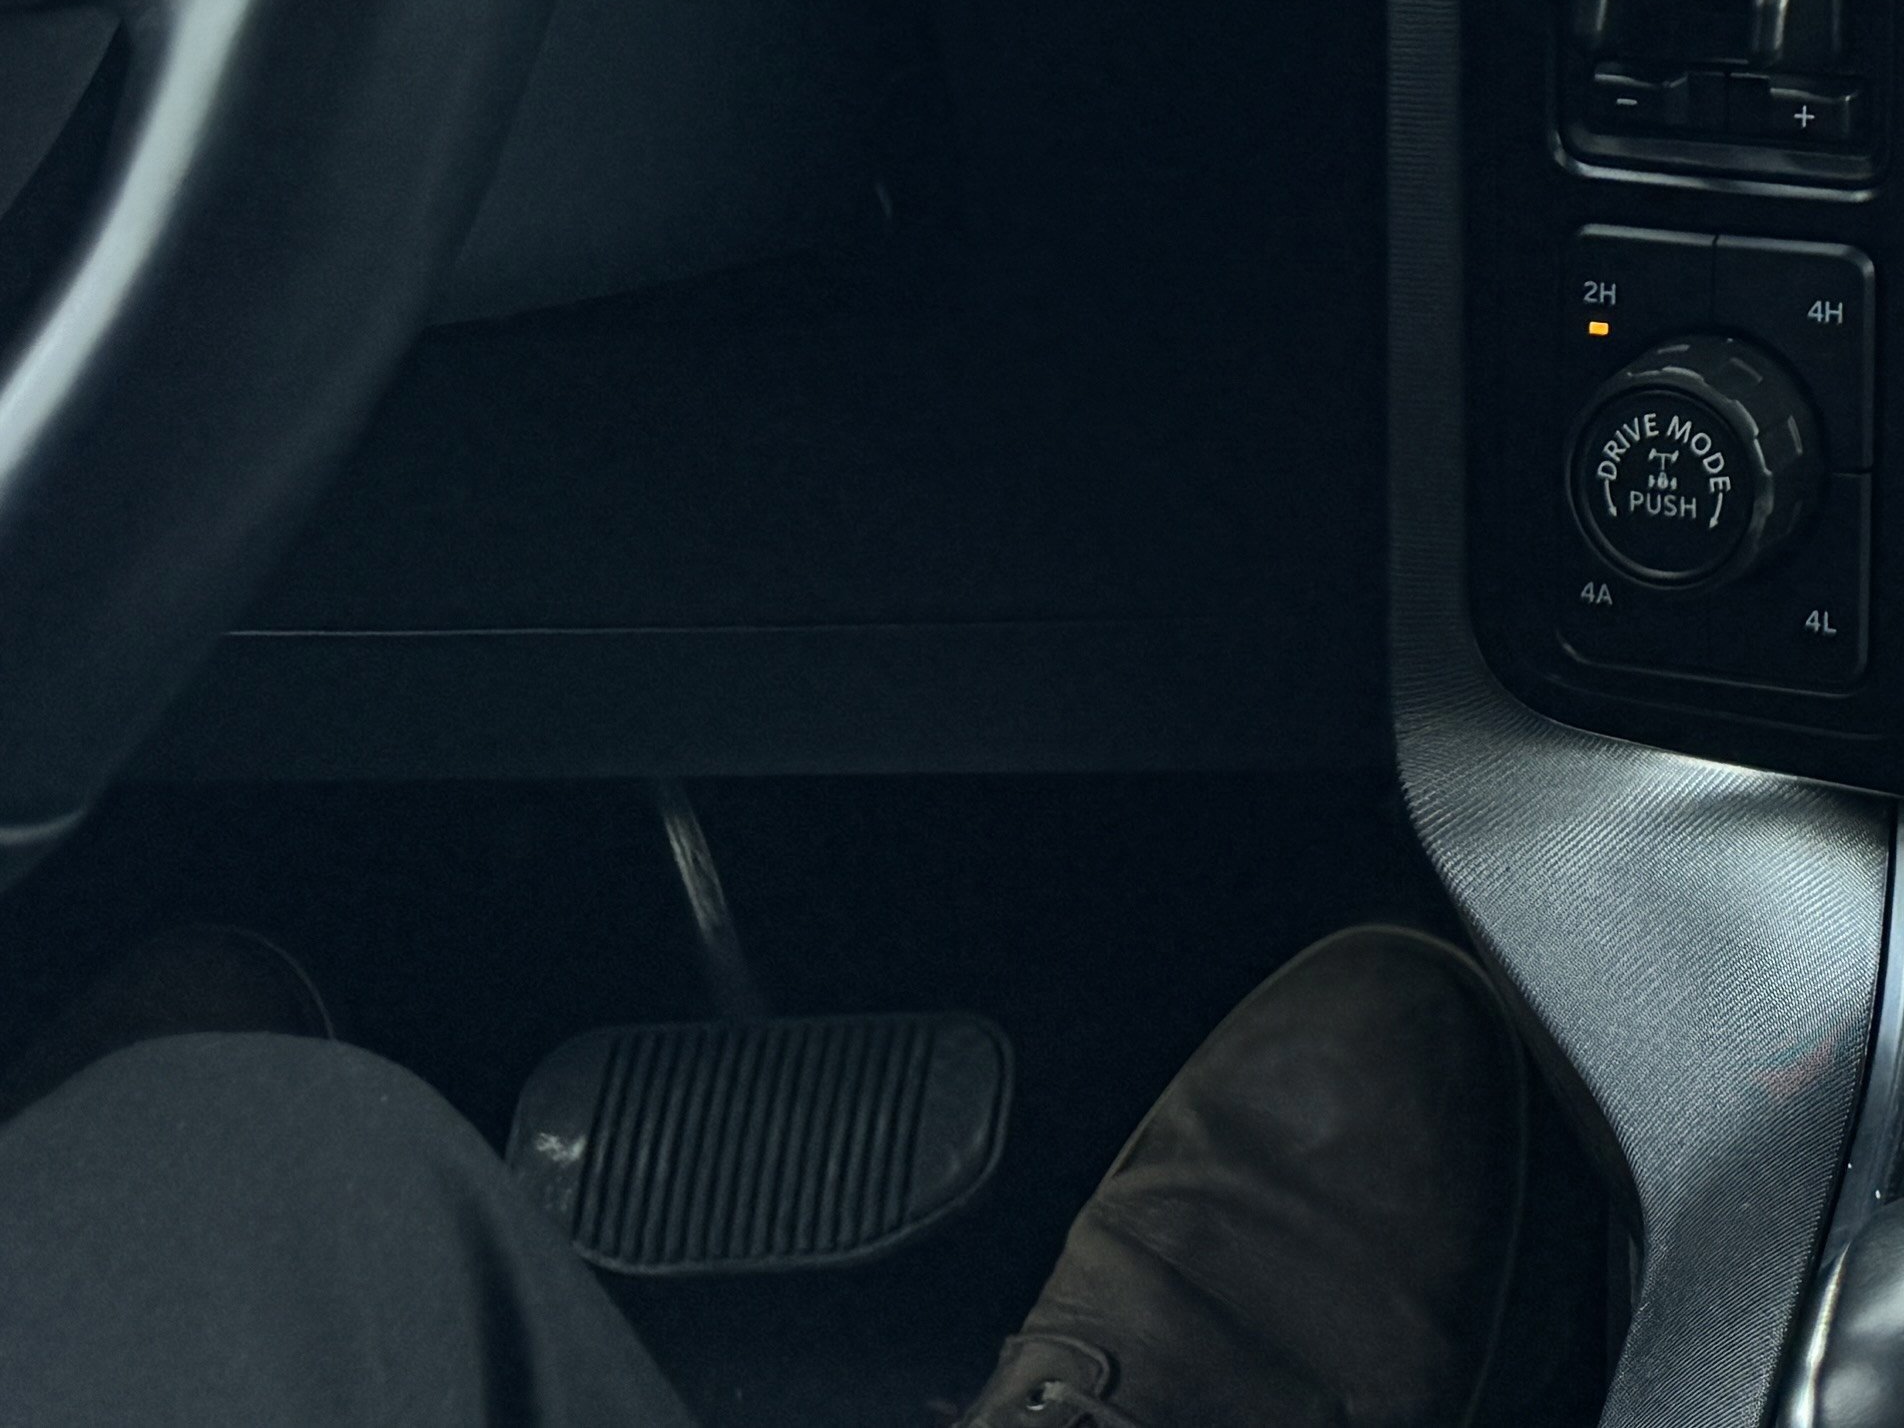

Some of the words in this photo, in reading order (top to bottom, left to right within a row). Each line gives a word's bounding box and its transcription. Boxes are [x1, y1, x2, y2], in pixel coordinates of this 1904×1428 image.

[1583, 282, 1617, 305] 2H
[1808, 301, 1844, 325] 4H
[1597, 413, 1659, 482] DRIVE
[1667, 414, 1731, 494] MODE
[1629, 490, 1698, 520] PUSH
[1580, 582, 1613, 606] 4A
[1805, 610, 1837, 635] 4L
